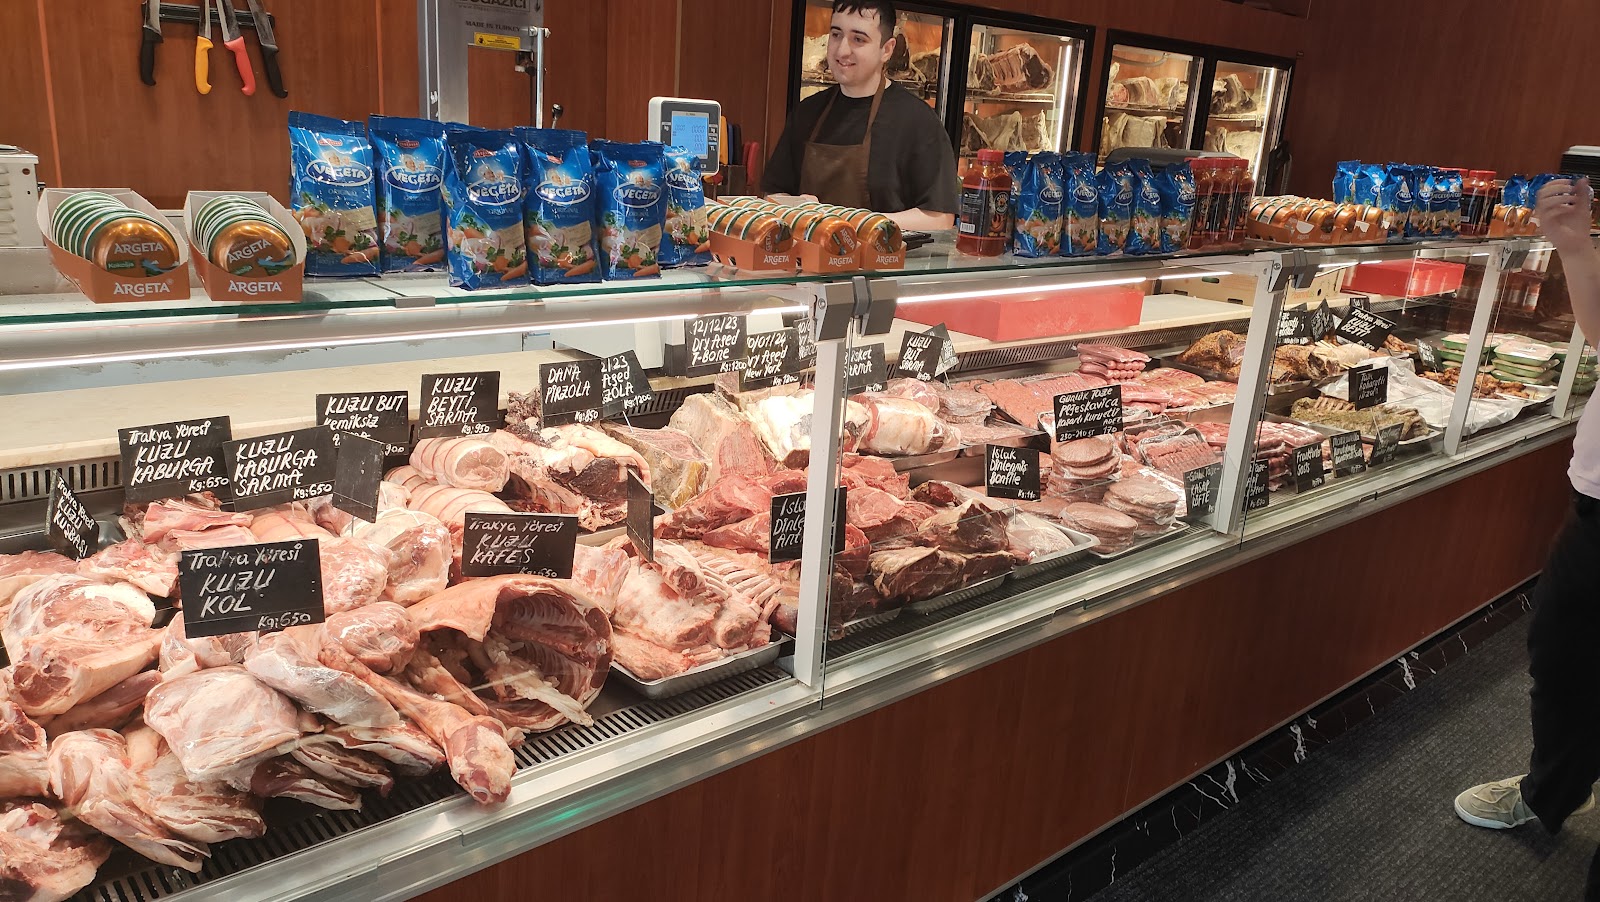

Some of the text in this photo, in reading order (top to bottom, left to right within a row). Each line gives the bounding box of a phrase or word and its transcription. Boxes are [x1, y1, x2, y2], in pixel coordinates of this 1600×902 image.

[313, 163, 367, 179] VEGETA
[391, 170, 440, 185] VEGETA
[470, 183, 518, 198] VEGETA
[541, 186, 586, 199] VEGETA
[619, 188, 657, 200] VEGETA
[840, 228, 855, 250] ARGETA
[114, 242, 164, 256] ARGETA
[227, 239, 272, 263] ARGETA
[763, 254, 789, 265] ARGETA
[828, 256, 853, 267] ARGETA
[876, 254, 899, 265] ARGETA
[113, 282, 170, 297] ARGETA
[228, 280, 282, 295] ARGETA
[692, 316, 737, 336] 12/12/23
[711, 328, 740, 350] Aged
[747, 354, 760, 368] ry
[761, 344, 789, 364] Aged
[547, 365, 581, 383] DANA
[431, 376, 478, 396] KUZU
[324, 394, 407, 416] KUZU BUT
[425, 406, 478, 427] SARMA
[128, 420, 211, 446] Trakya Yöresi
[461, 423, 490, 434] Kg:950
[134, 440, 191, 468] KUZU
[236, 434, 294, 462] KUZU
[130, 456, 215, 486] KABURGA
[233, 449, 318, 482] KABURGA
[188, 477, 229, 492] Kg:650
[235, 468, 303, 496] SARMA
[293, 483, 332, 499] Kg:650
[780, 496, 806, 517] Isla
[469, 518, 516, 533] Trakya
[476, 533, 538, 549] KUZU
[469, 547, 534, 565] KAFES
[199, 568, 276, 597] KUZU
[201, 592, 252, 618] KOL
